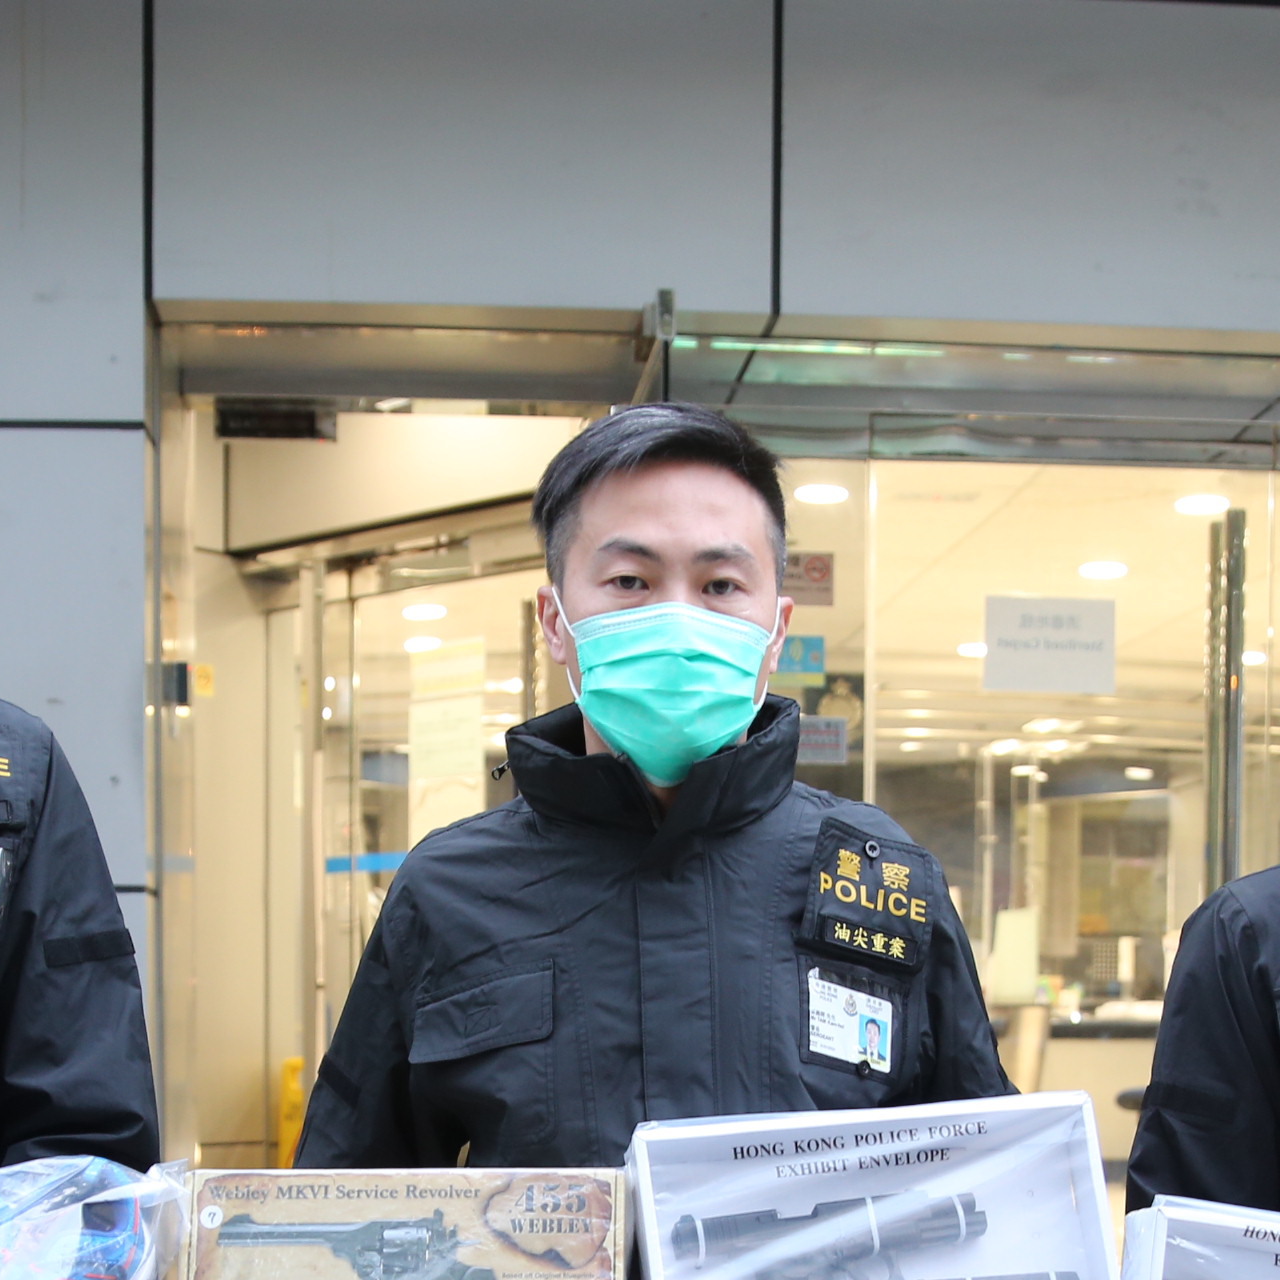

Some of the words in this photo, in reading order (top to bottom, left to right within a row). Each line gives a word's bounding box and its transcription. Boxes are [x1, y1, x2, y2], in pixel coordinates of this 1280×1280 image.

[837, 848, 910, 892] 警察
[820, 871, 927, 923] POLICE
[834, 922, 906, 959] 油尖重案
[732, 1141, 785, 1160] HONG
[794, 1135, 845, 1154] KONG
[854, 1128, 919, 1148] POLICE
[928, 1120, 988, 1139] FORCE
[775, 1159, 850, 1179] EXHIBIT
[858, 1148, 951, 1170] ENVELOPE
[209, 1185, 269, 1203] Webley
[276, 1185, 330, 1199] MKVI
[336, 1185, 398, 1199] Service
[405, 1185, 480, 1199] Revolver
[207, 1211, 216, 1224] 7
[510, 1217, 592, 1234] WEBLEY
